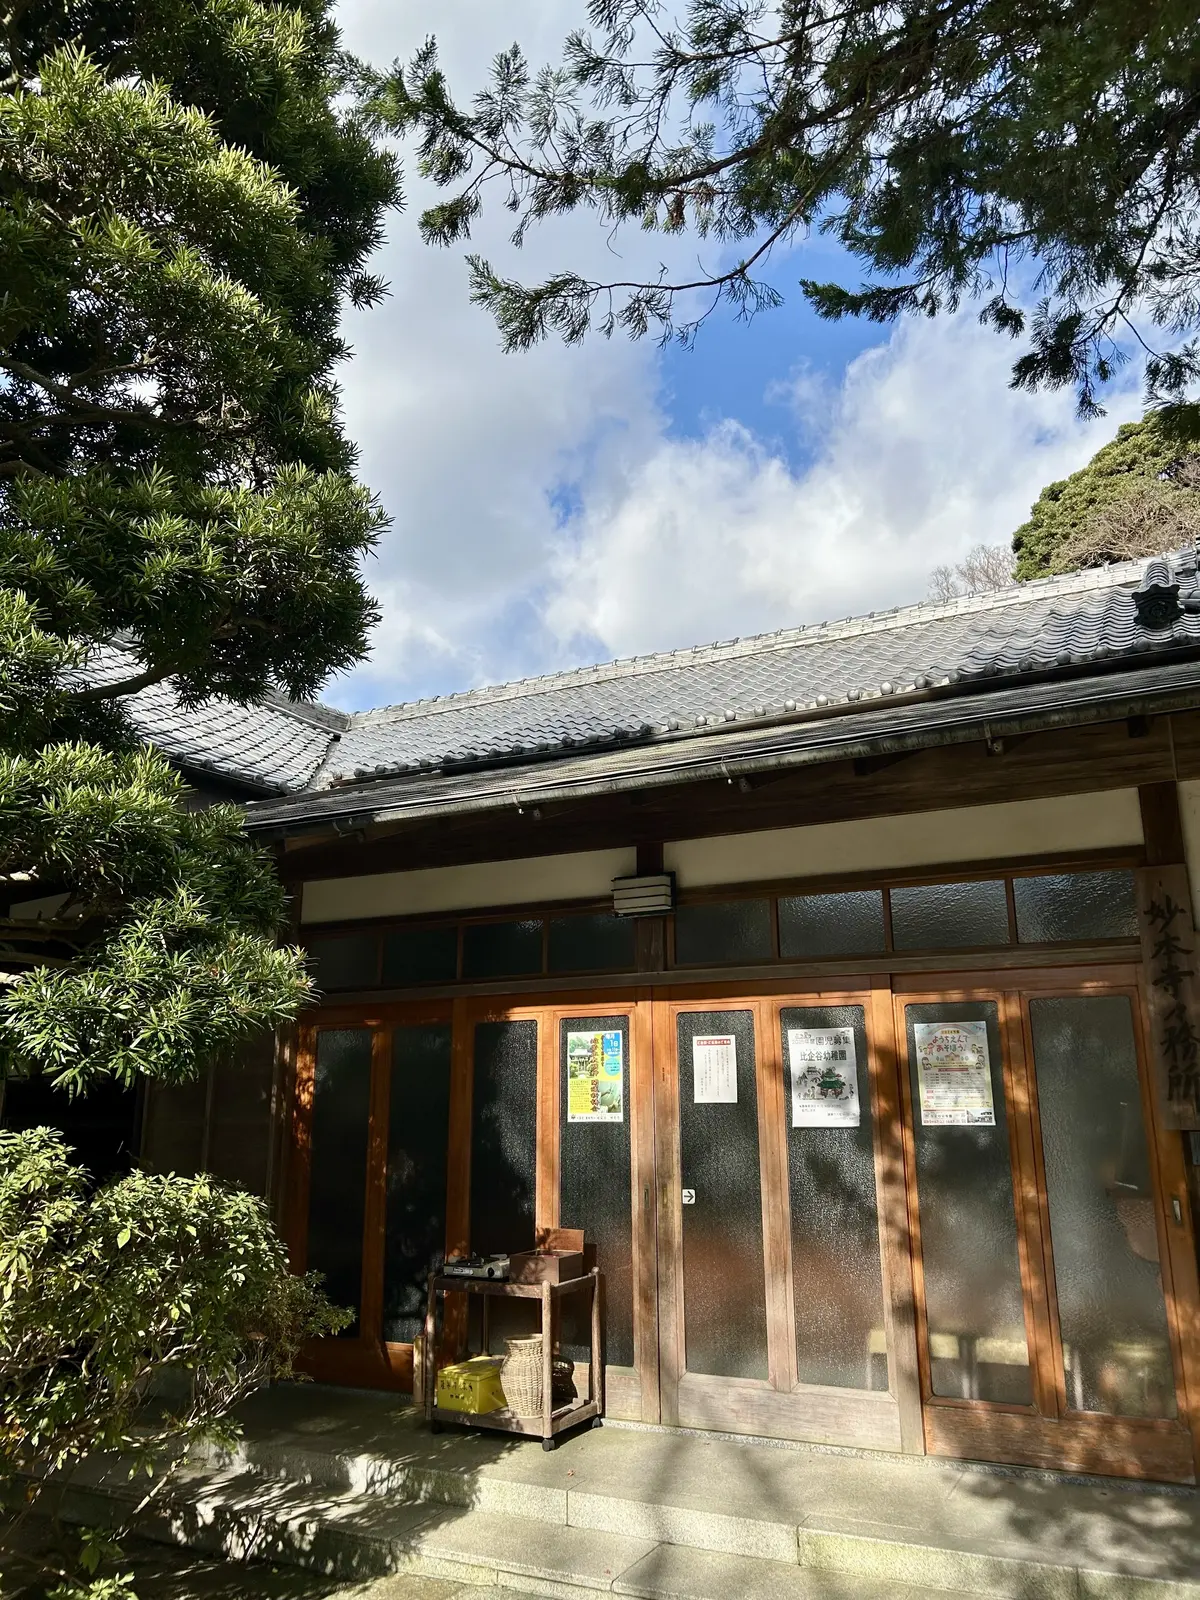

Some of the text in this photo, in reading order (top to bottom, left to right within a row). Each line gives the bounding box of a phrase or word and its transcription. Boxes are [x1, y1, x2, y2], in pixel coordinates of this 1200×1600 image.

[800, 1049, 847, 1061] 比企谷幼稚園
